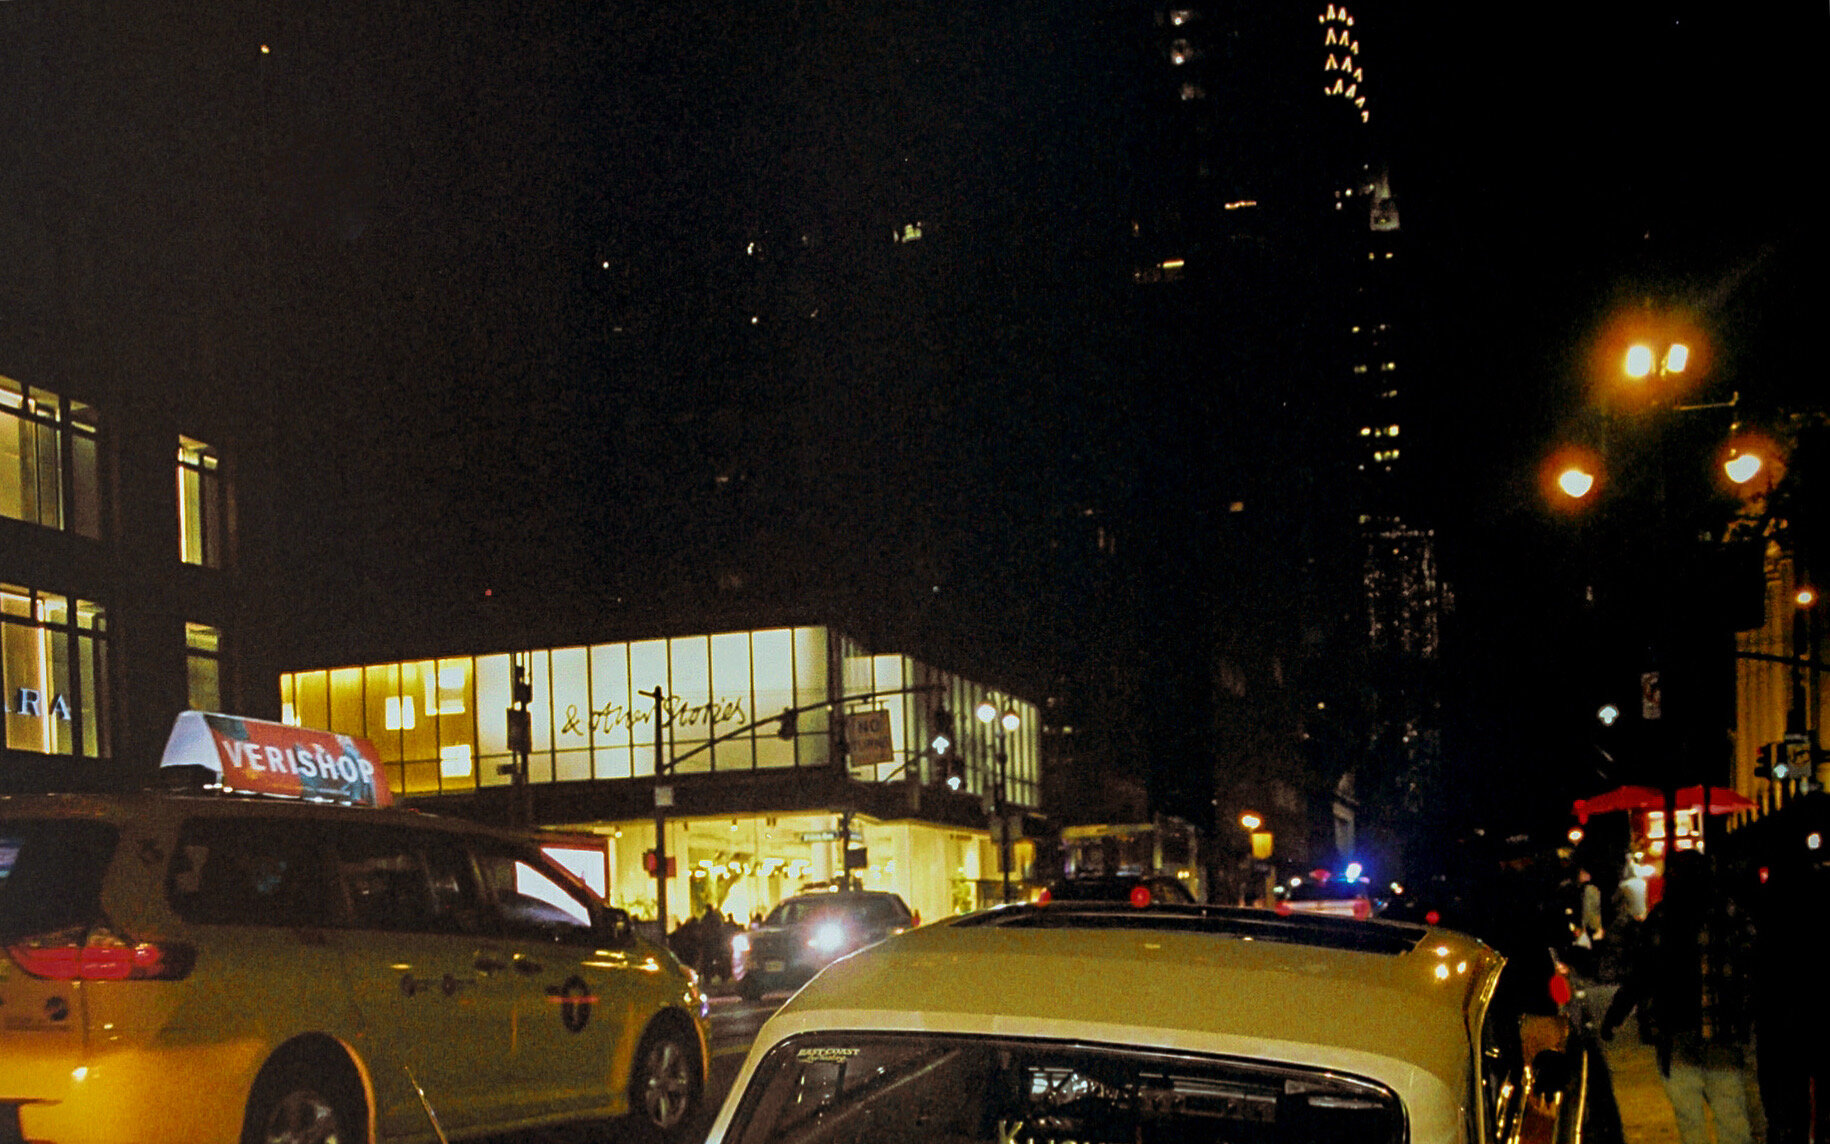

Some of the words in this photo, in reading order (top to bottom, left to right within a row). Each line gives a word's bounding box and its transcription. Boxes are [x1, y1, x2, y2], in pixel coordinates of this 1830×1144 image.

[4, 687, 72, 721] RA
[562, 704, 584, 736] &
[591, 701, 655, 734] other
[661, 695, 746, 728] Stories
[222, 740, 375, 784] VERISHOP
